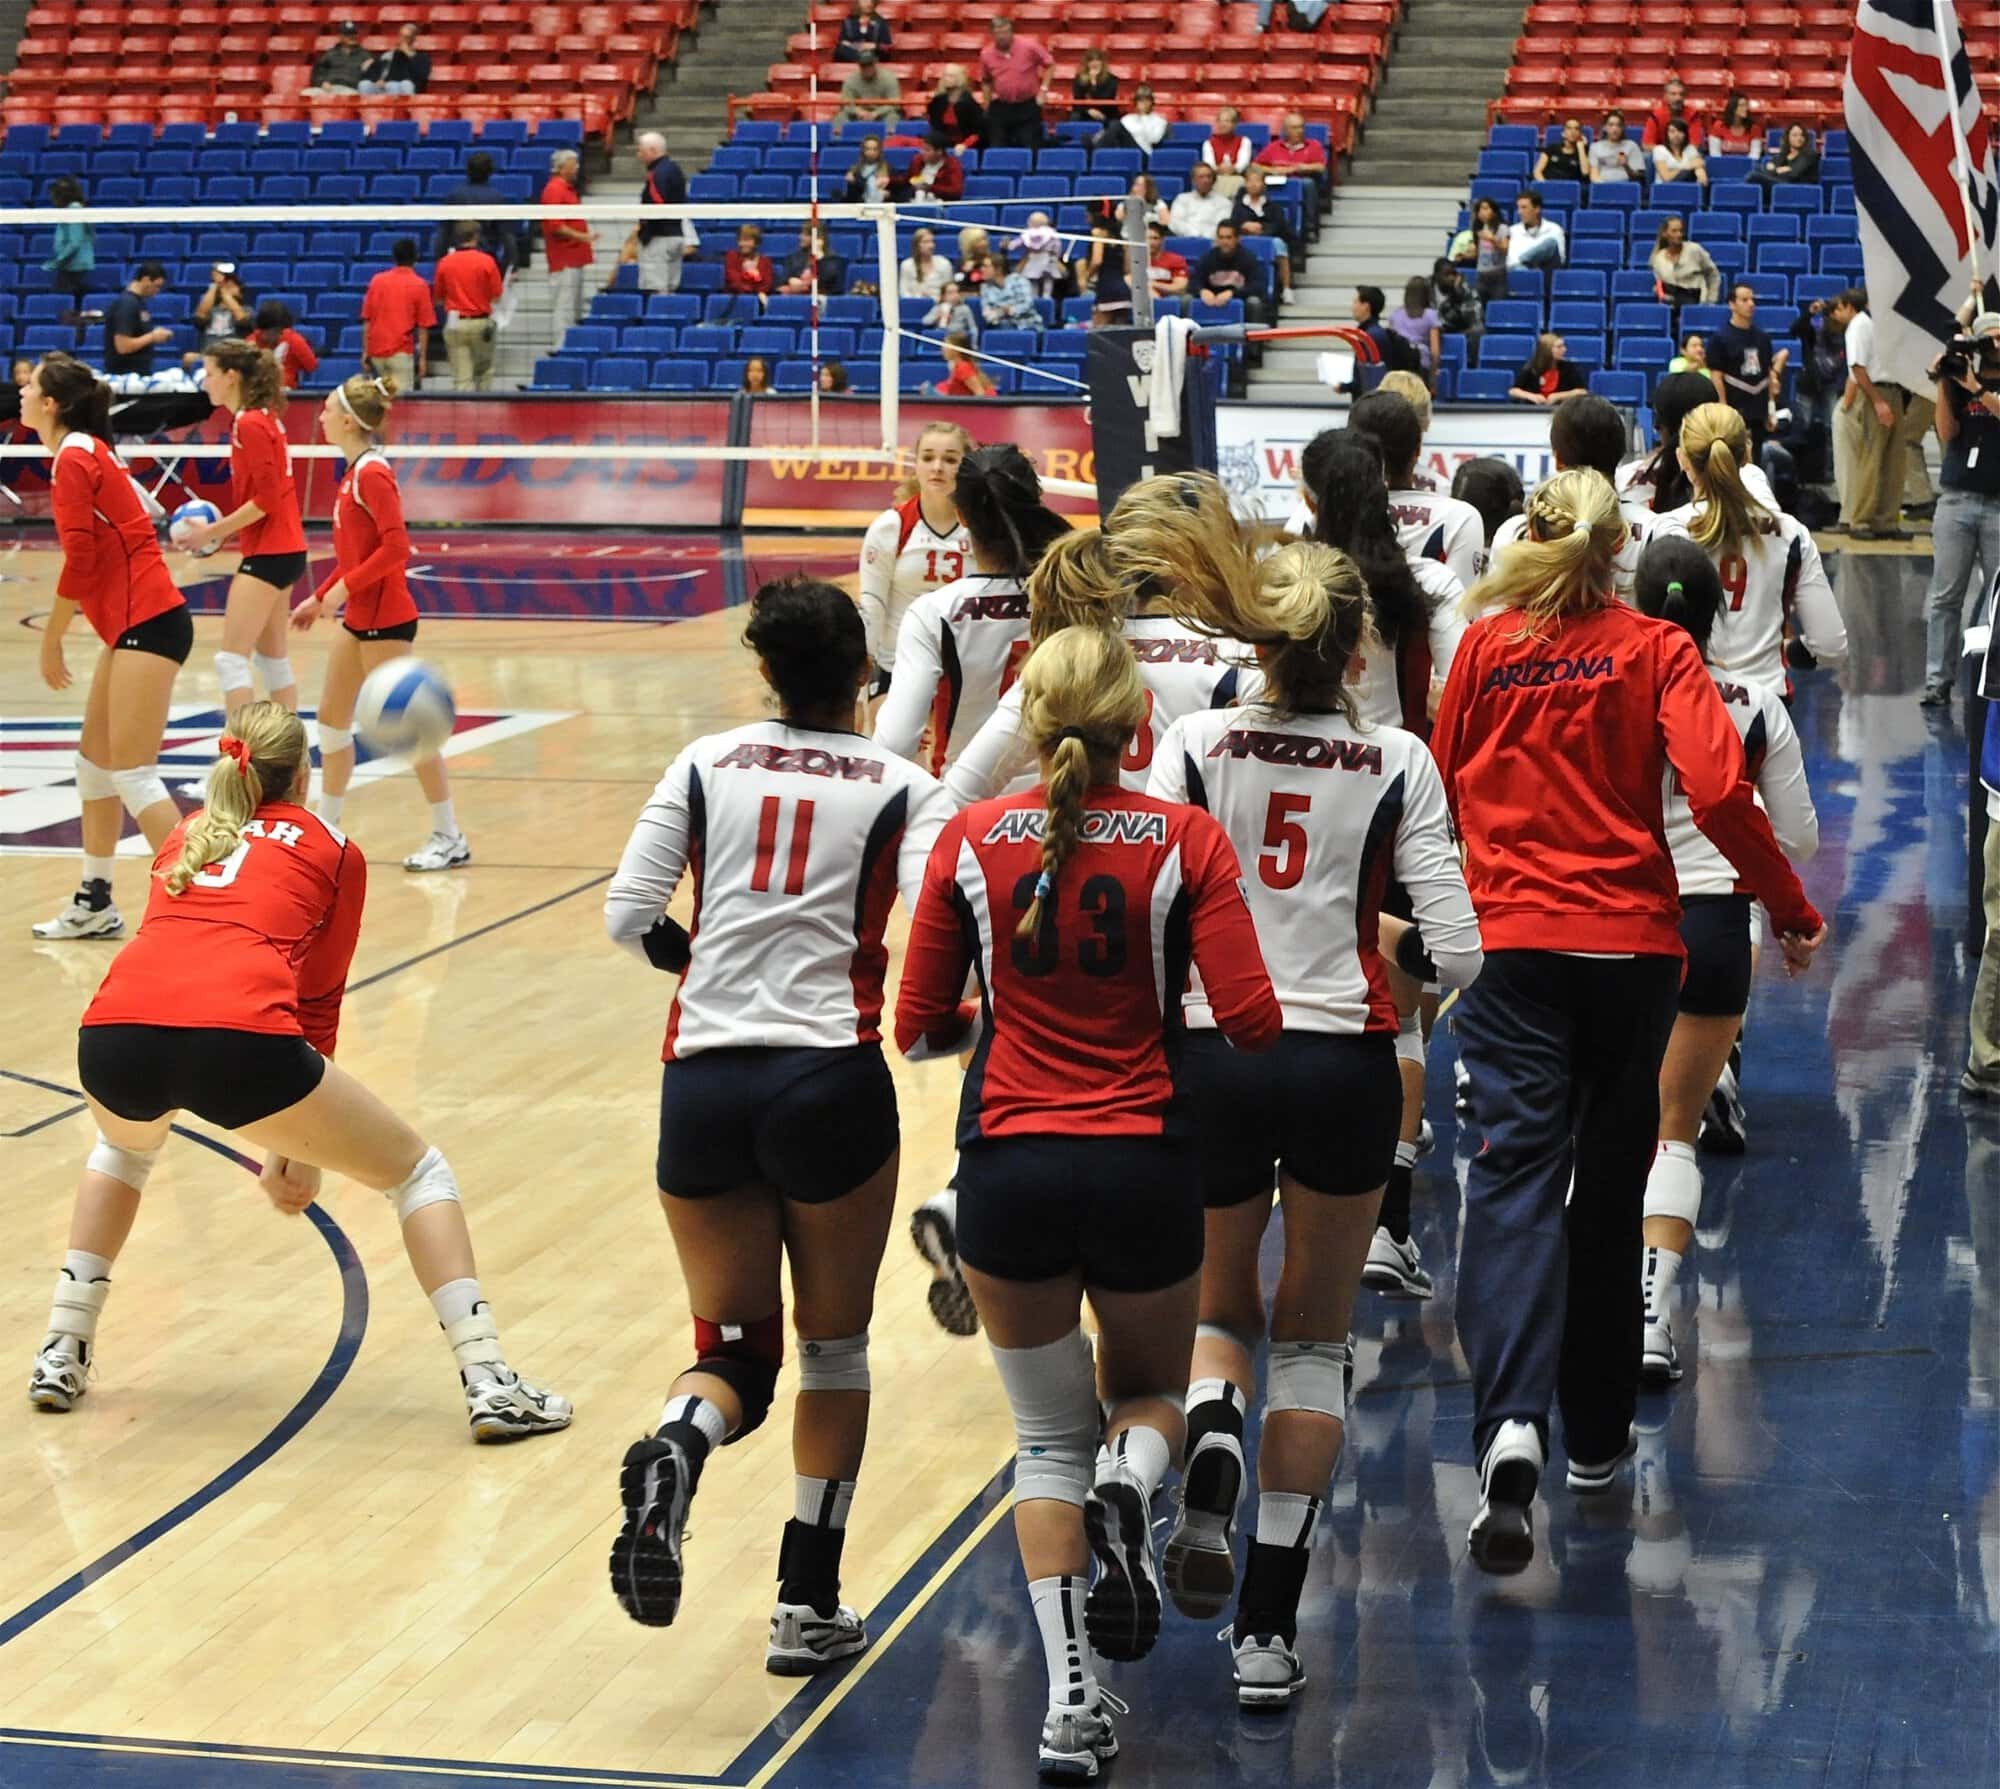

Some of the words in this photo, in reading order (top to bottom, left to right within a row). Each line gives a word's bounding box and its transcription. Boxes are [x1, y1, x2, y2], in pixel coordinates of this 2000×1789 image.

[334, 432, 707, 488] ILDCATS
[763, 445, 915, 482] WELL
[923, 550, 964, 582] 13
[1719, 553, 1748, 612] 9
[952, 595, 1032, 622] ARIZO
[1127, 639, 1218, 666] ZONA
[1483, 655, 1614, 696] ARIZONA
[713, 744, 885, 784] ARIZONA
[1207, 730, 1382, 776] ARIZONA
[240, 819, 304, 848] AH
[750, 796, 815, 896] 11
[983, 809, 1167, 845] ARONA
[1258, 792, 1312, 890] 5
[1011, 874, 1126, 978] 33
